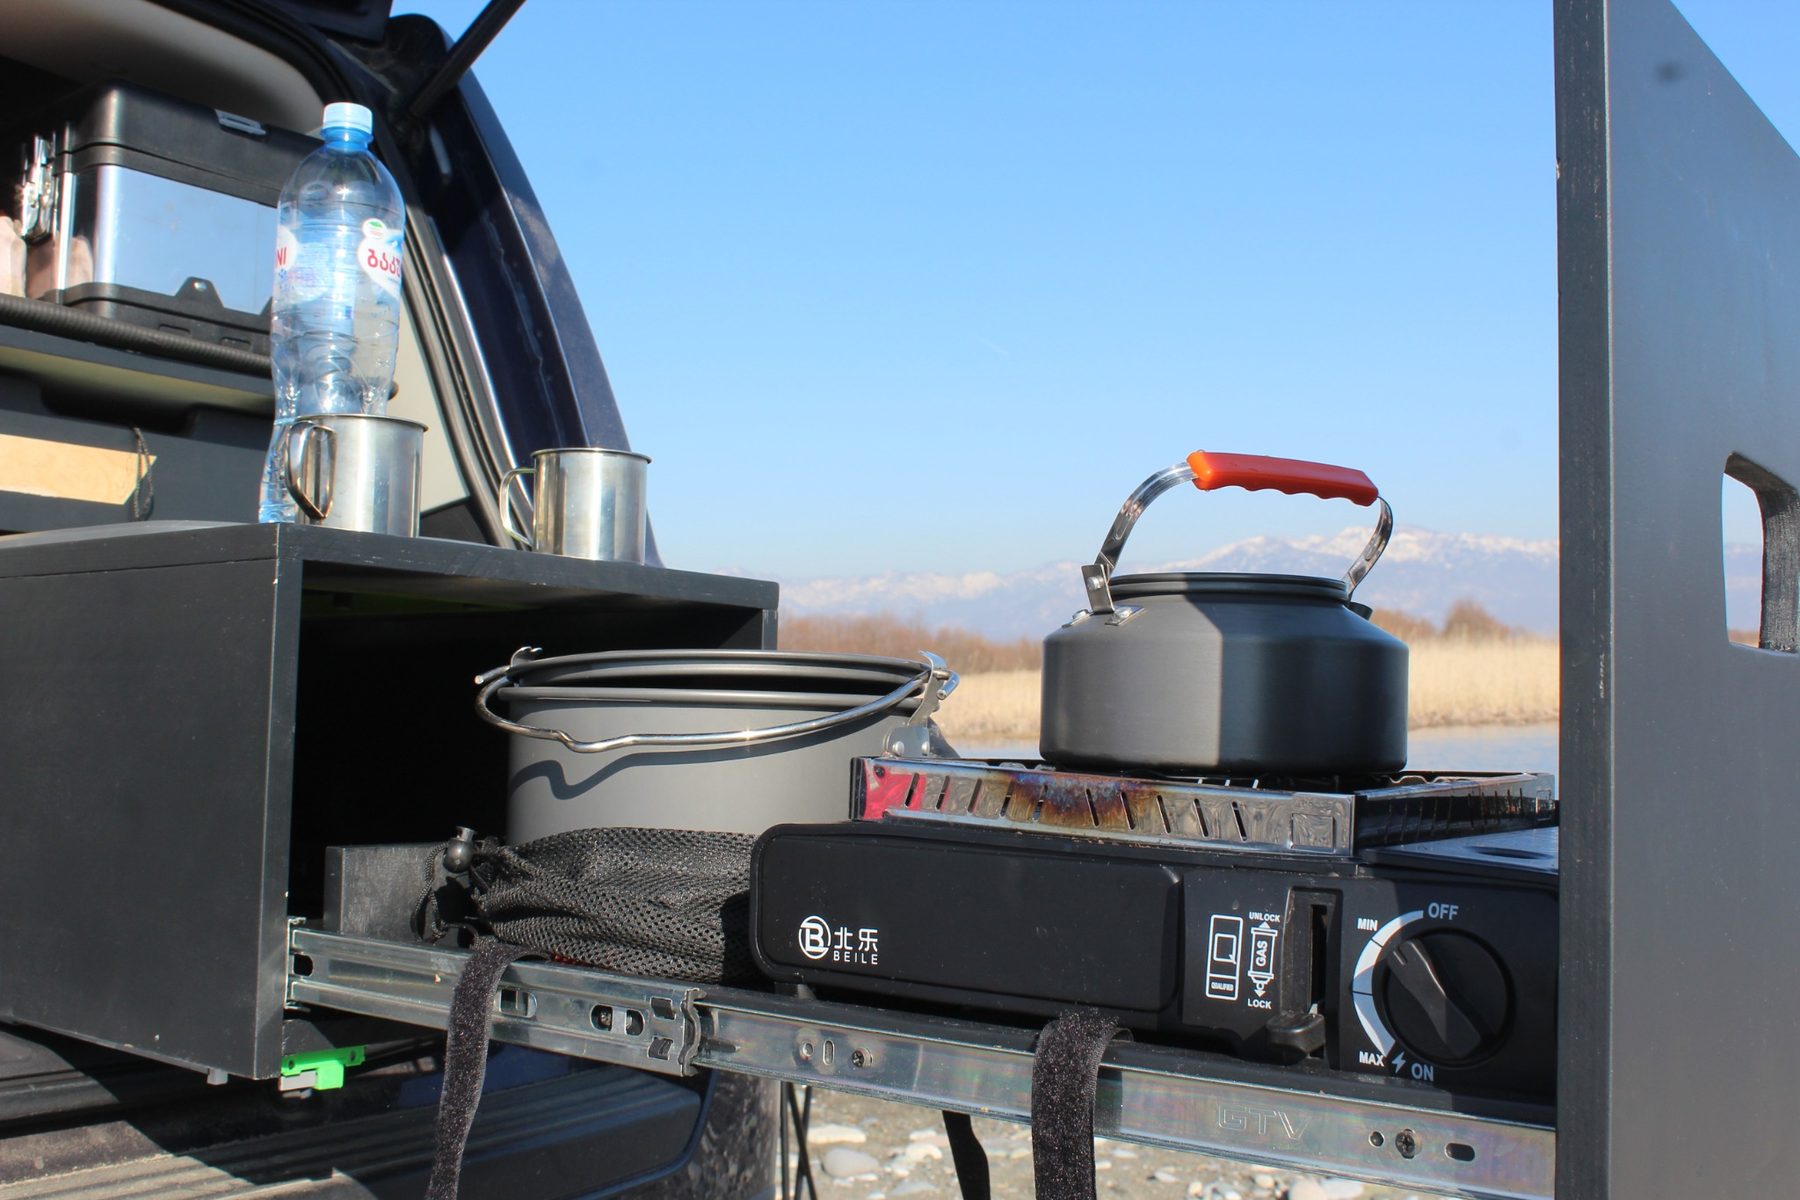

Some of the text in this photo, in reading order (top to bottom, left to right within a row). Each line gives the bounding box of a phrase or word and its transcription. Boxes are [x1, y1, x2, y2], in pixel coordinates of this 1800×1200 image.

[1248, 911, 1281, 923] UNLOCK
[1428, 902, 1459, 920] OFF
[1357, 917, 1378, 931] MIN
[834, 926, 878, 952] 北乐
[833, 950, 879, 965] BEILE
[1255, 940, 1268, 967] GAS
[1247, 998, 1272, 1009] LOCK
[1359, 1051, 1384, 1067] MAX
[1411, 1062, 1435, 1082] ON
[1218, 1104, 1312, 1140] GTV
